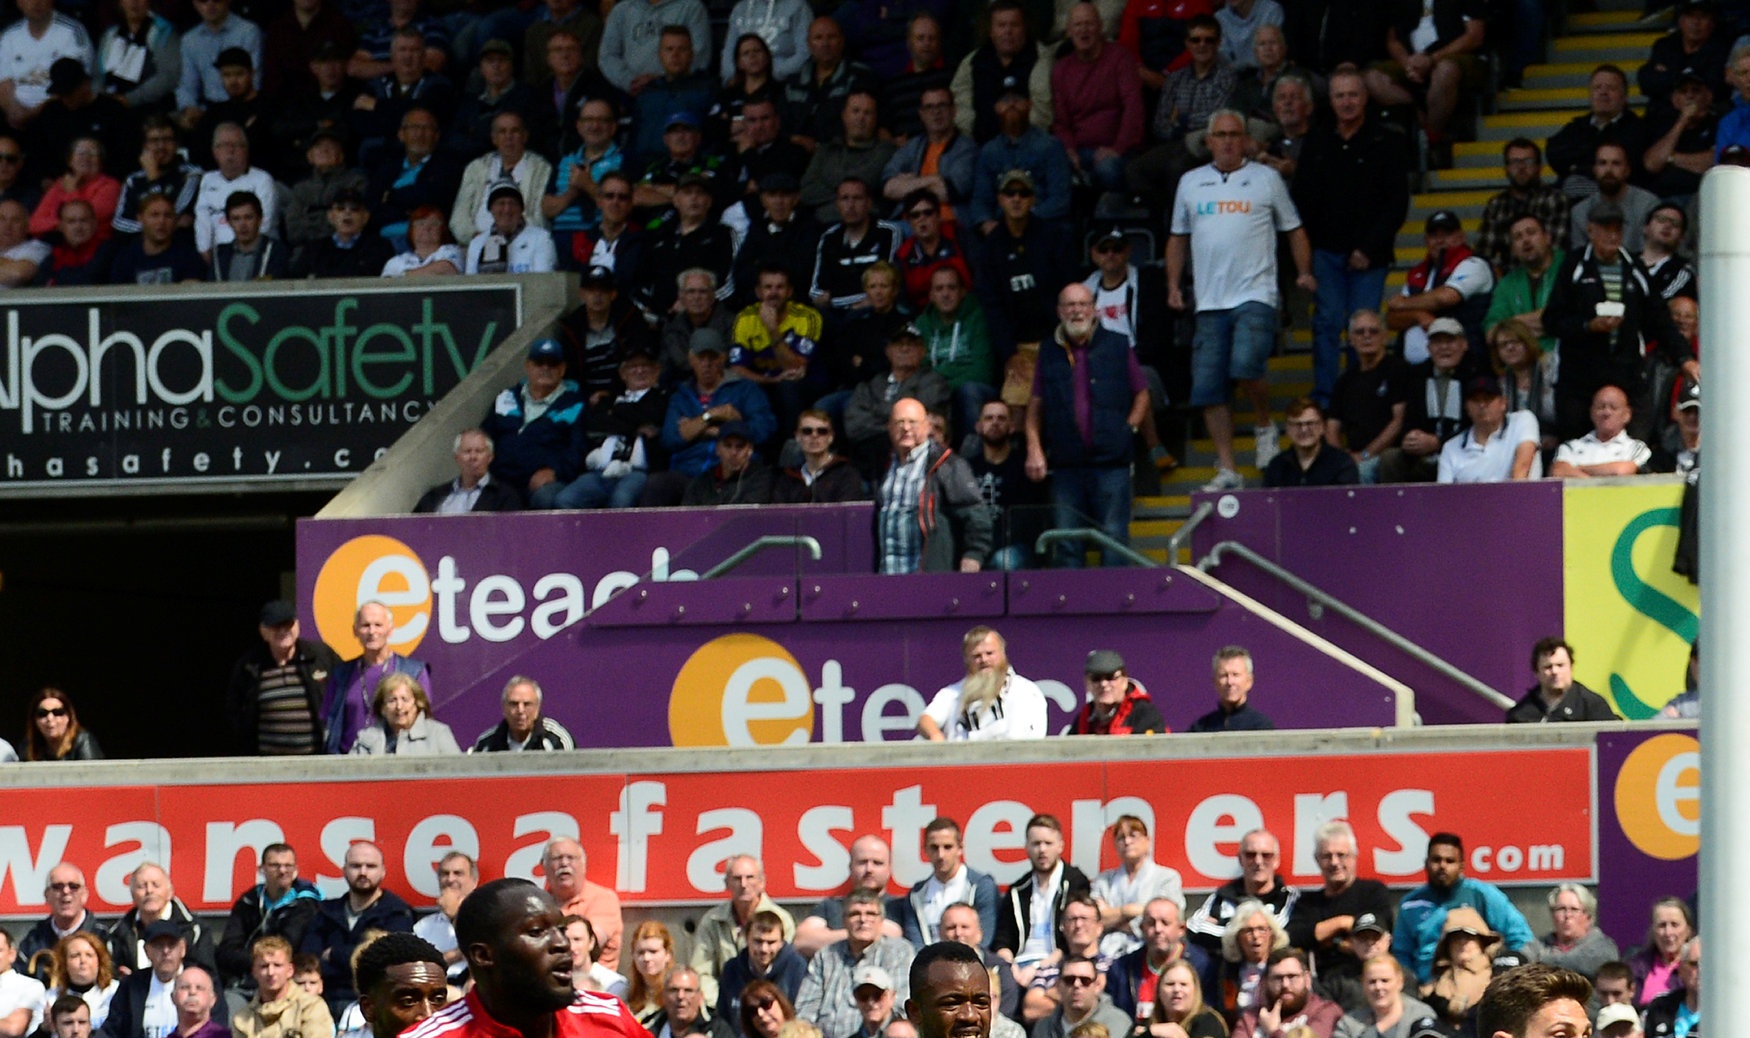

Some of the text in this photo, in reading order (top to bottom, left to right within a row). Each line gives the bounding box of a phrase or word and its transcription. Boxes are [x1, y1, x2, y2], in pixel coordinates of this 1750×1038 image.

[1197, 200, 1252, 215] LETOU
[0, 298, 497, 434] lphaSafety
[42, 408, 189, 433] TRAINING
[217, 402, 437, 428] CONSULTANC
